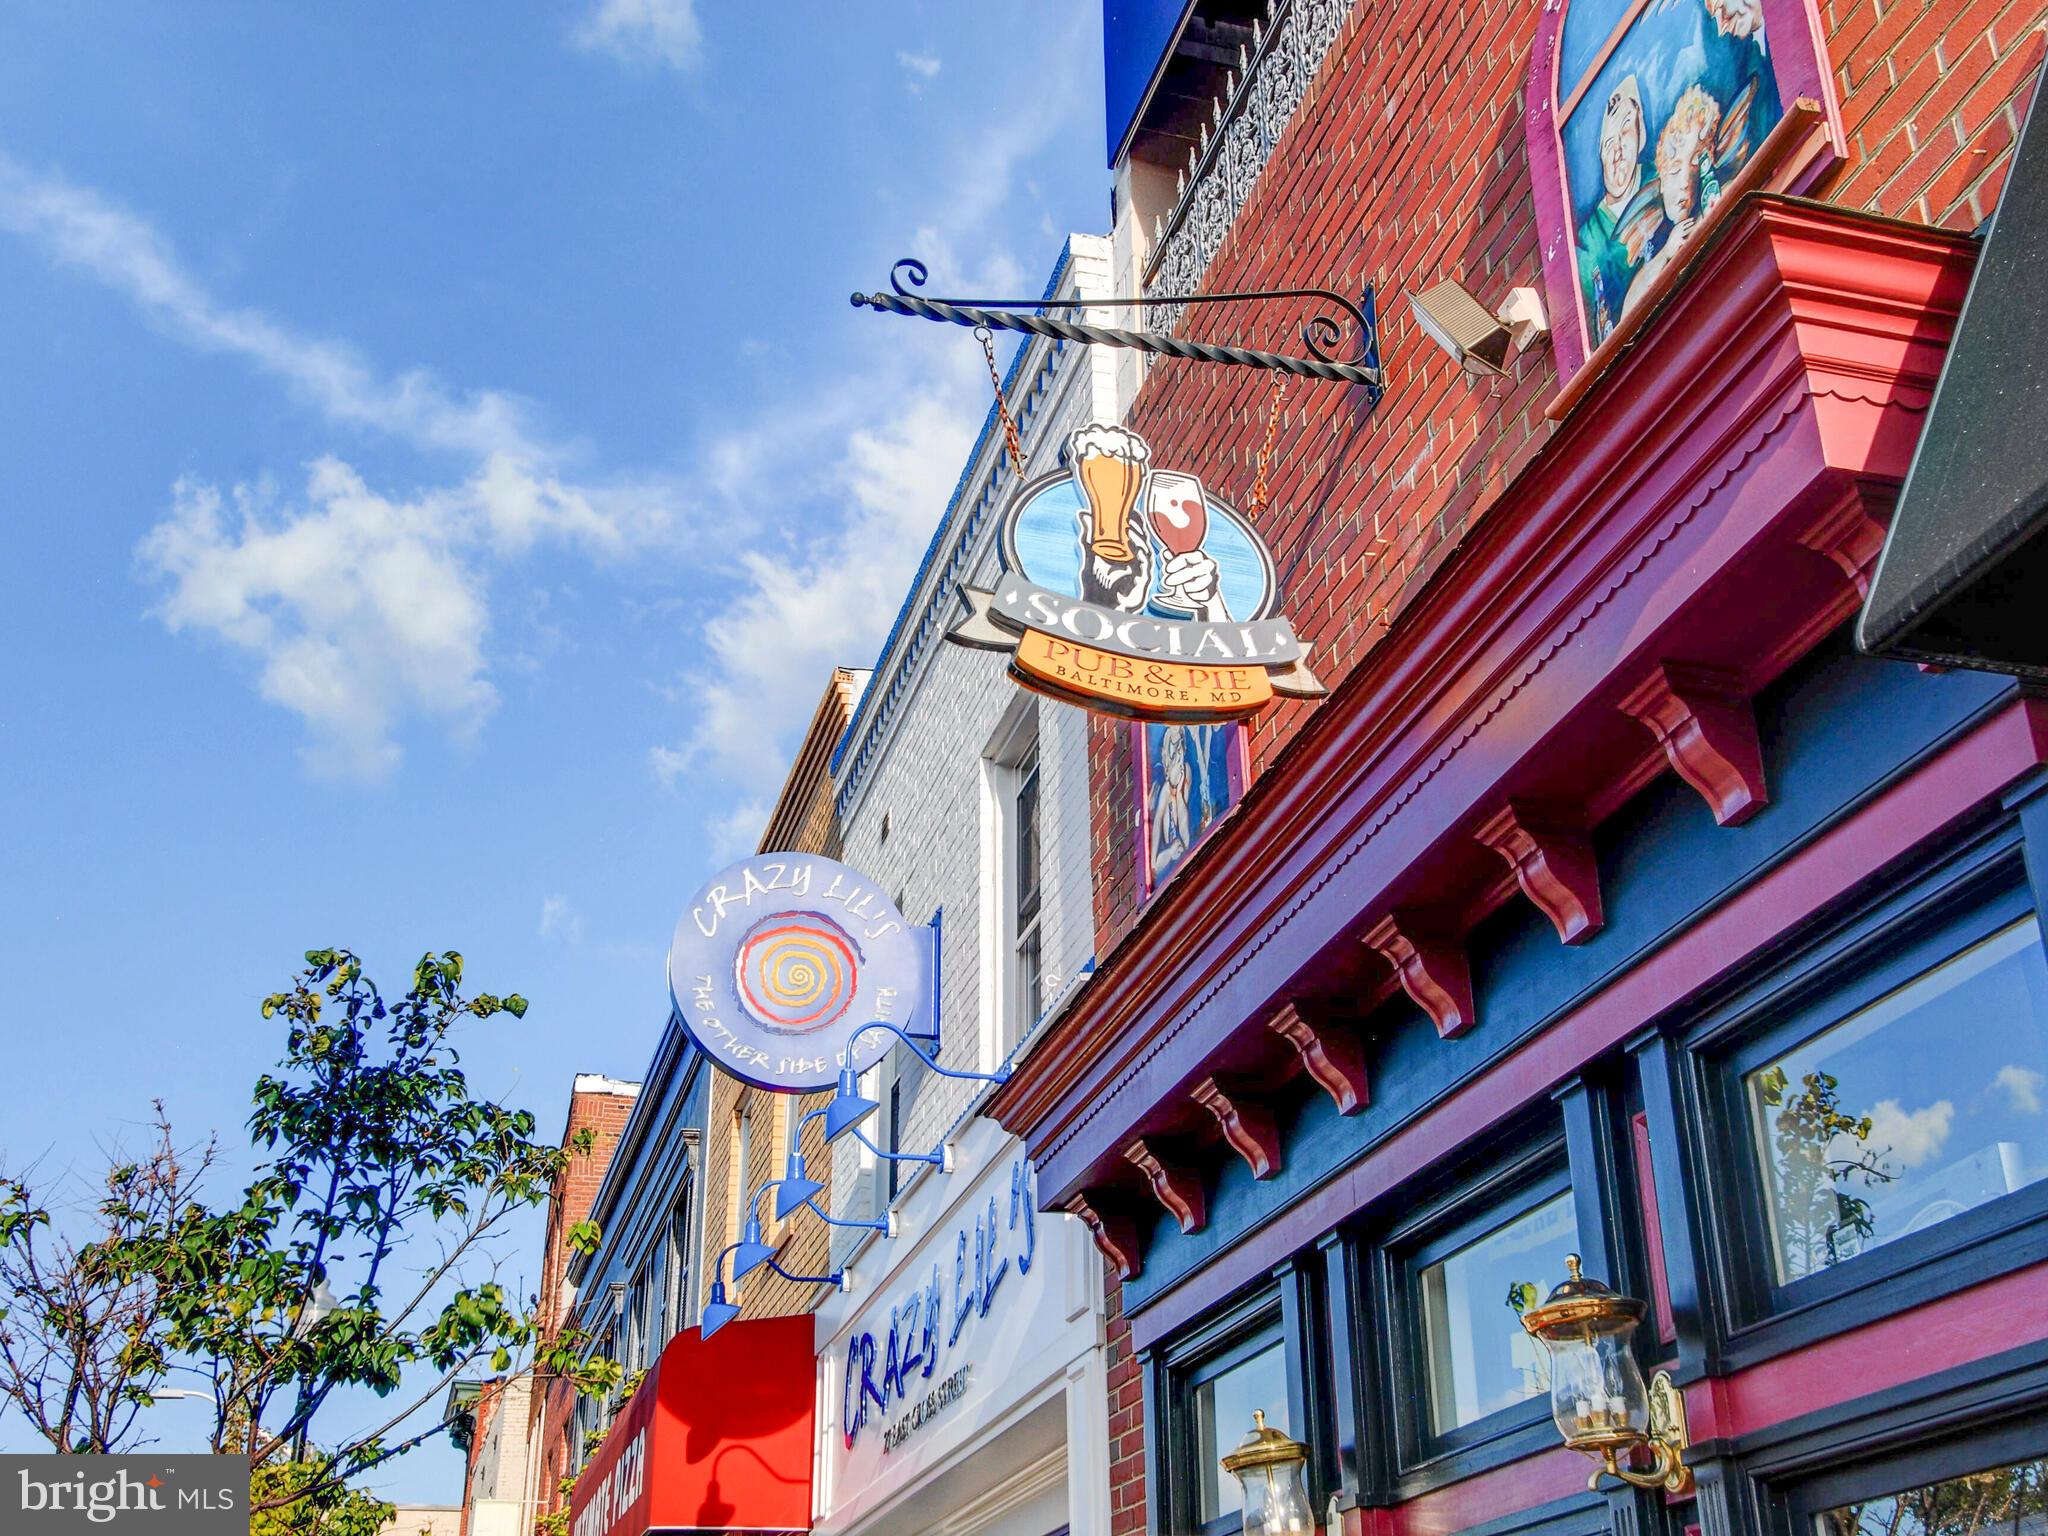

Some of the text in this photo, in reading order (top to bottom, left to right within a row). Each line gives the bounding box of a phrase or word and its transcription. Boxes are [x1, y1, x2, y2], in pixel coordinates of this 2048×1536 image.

[1024, 589, 1277, 659] SOCIAL
[1044, 638, 1251, 691] PUB & PIE
[1055, 665, 1242, 703] BALTIMORE, MD
[692, 863, 901, 940] CRAZY LIL'S
[692, 975, 715, 1012] THE
[702, 1017, 770, 1070] OTHER
[776, 1056, 828, 1075] SIDE
[844, 1155, 1036, 1451] CRAZY LIL'S
[892, 1412, 910, 1449] EAST
[911, 1389, 937, 1431] CROSS
[937, 1363, 972, 1410] STREET
[611, 1426, 646, 1528] PIZZA
